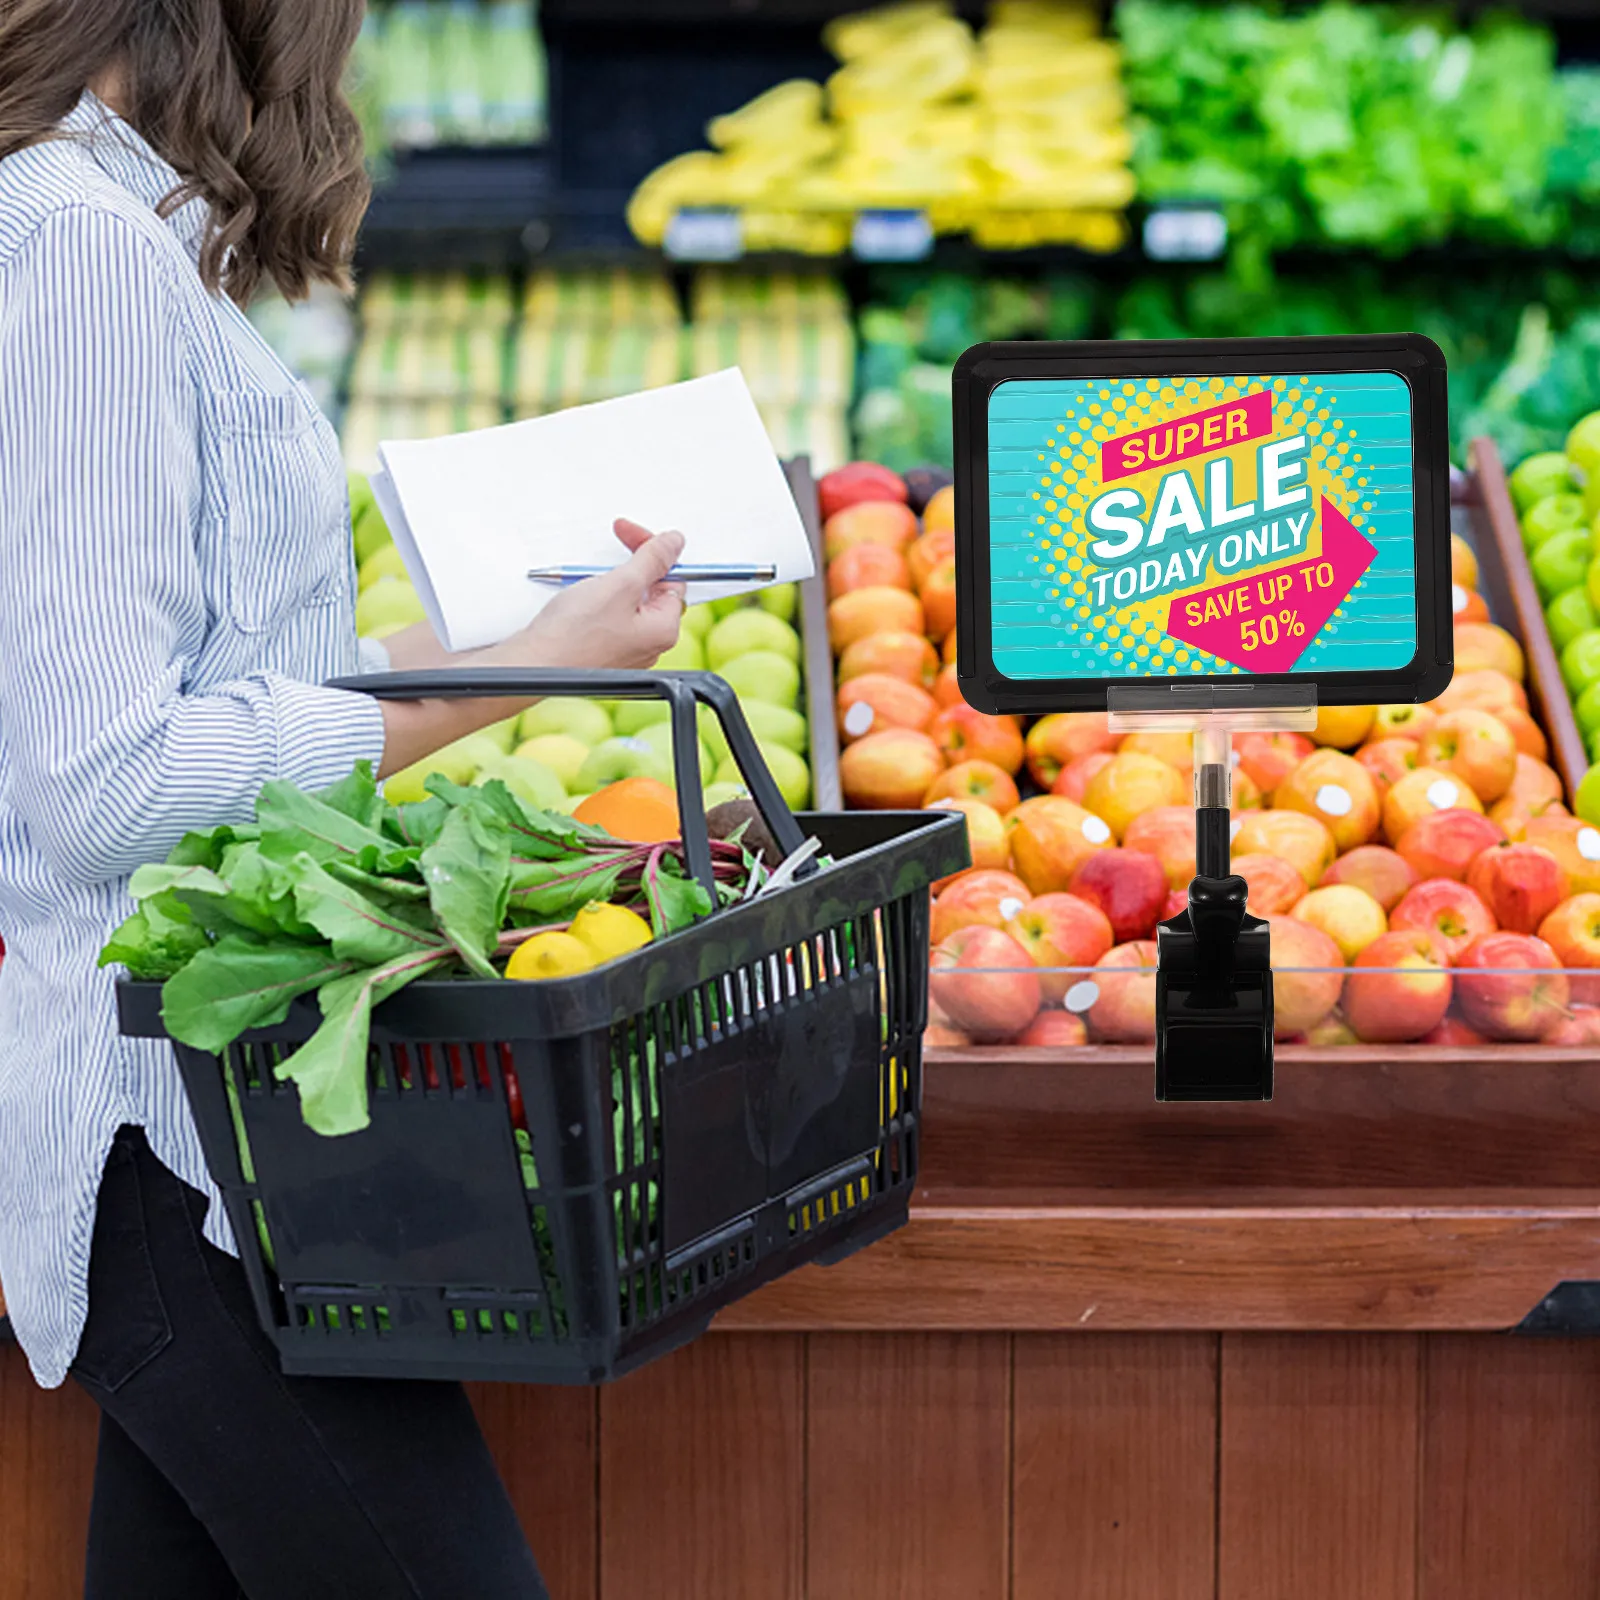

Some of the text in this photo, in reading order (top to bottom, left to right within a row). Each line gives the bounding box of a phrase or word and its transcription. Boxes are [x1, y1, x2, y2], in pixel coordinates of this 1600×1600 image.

[1121, 408, 1248, 469] SUPER
[1090, 435, 1307, 559] SALE
[1092, 512, 1309, 607] TODAY ONLY
[1184, 562, 1334, 627] SAVE UP TO
[1240, 609, 1305, 652] 50%
